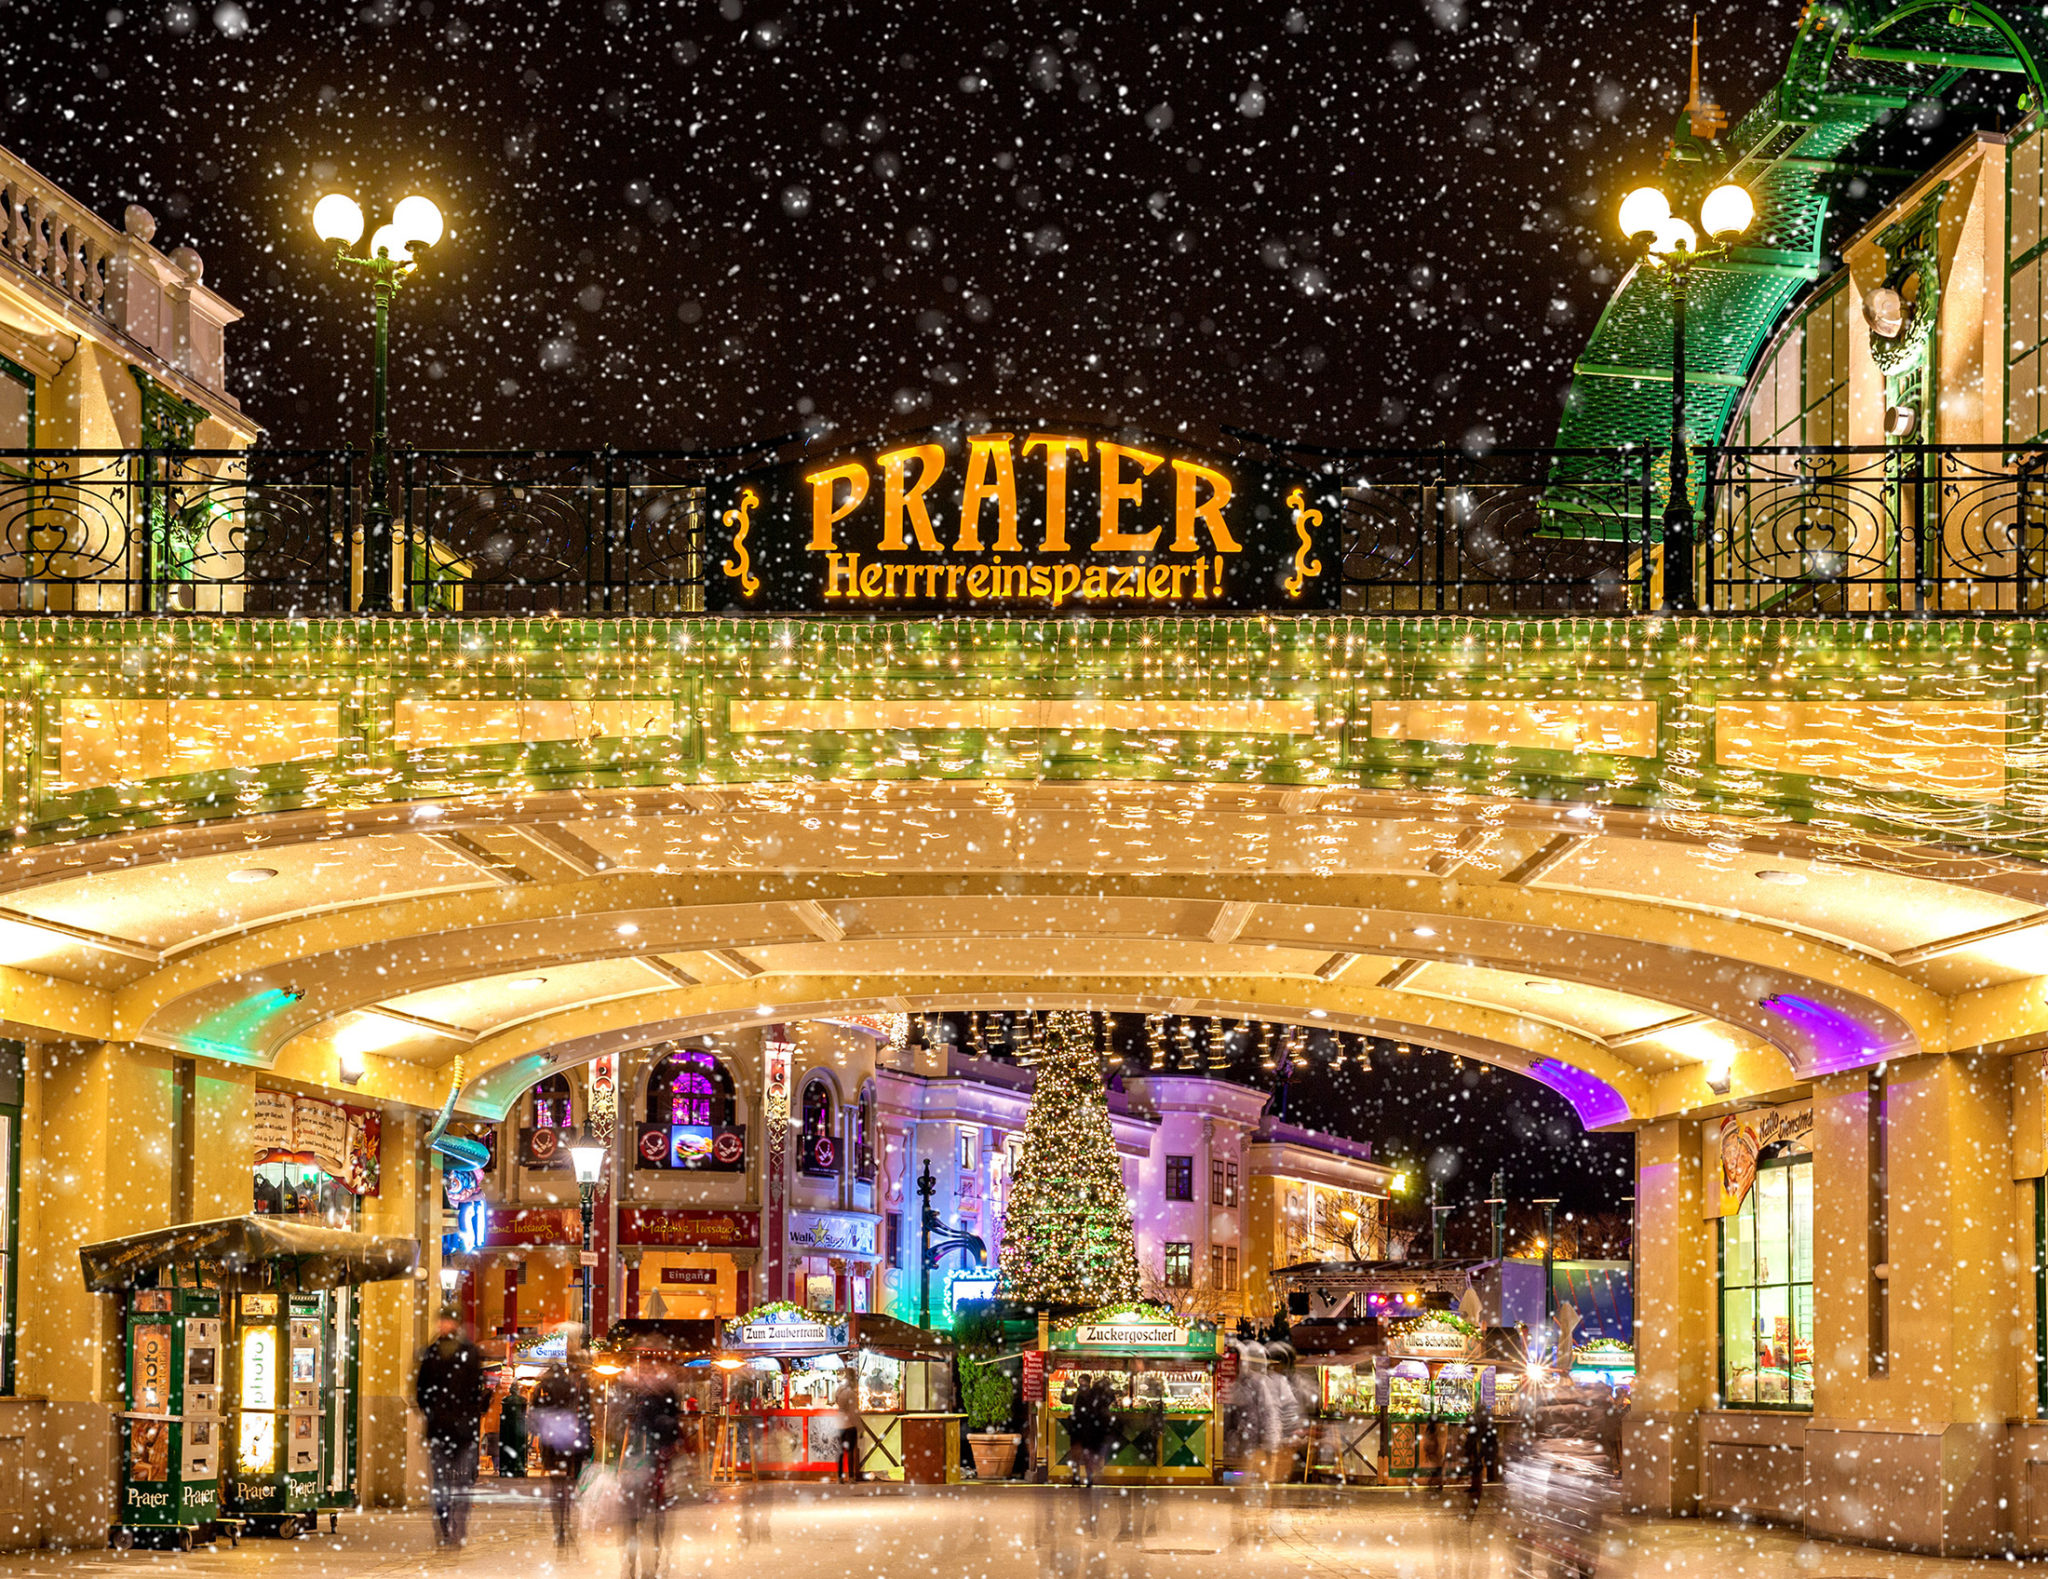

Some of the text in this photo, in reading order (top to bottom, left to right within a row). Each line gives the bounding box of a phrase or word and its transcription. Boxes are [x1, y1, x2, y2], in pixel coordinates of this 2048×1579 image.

[804, 431, 1243, 553] PRATER
[824, 553, 1224, 607] Herrrreinspaziert!
[1760, 1110, 1779, 1141] Hallo
[641, 1216, 742, 1241] Madame Tussauds
[789, 1231, 815, 1243] Walk
[668, 1271, 710, 1282] Eingang
[746, 1326, 824, 1340] Zum Zaubertrank
[1086, 1326, 1177, 1344] Zuckergoscherl
[1424, 1334, 1463, 1348] Schokolade
[127, 1487, 169, 1508] Prater
[183, 1486, 216, 1508] Prater
[237, 1482, 277, 1501] Prater
[289, 1478, 317, 1498] Prater
